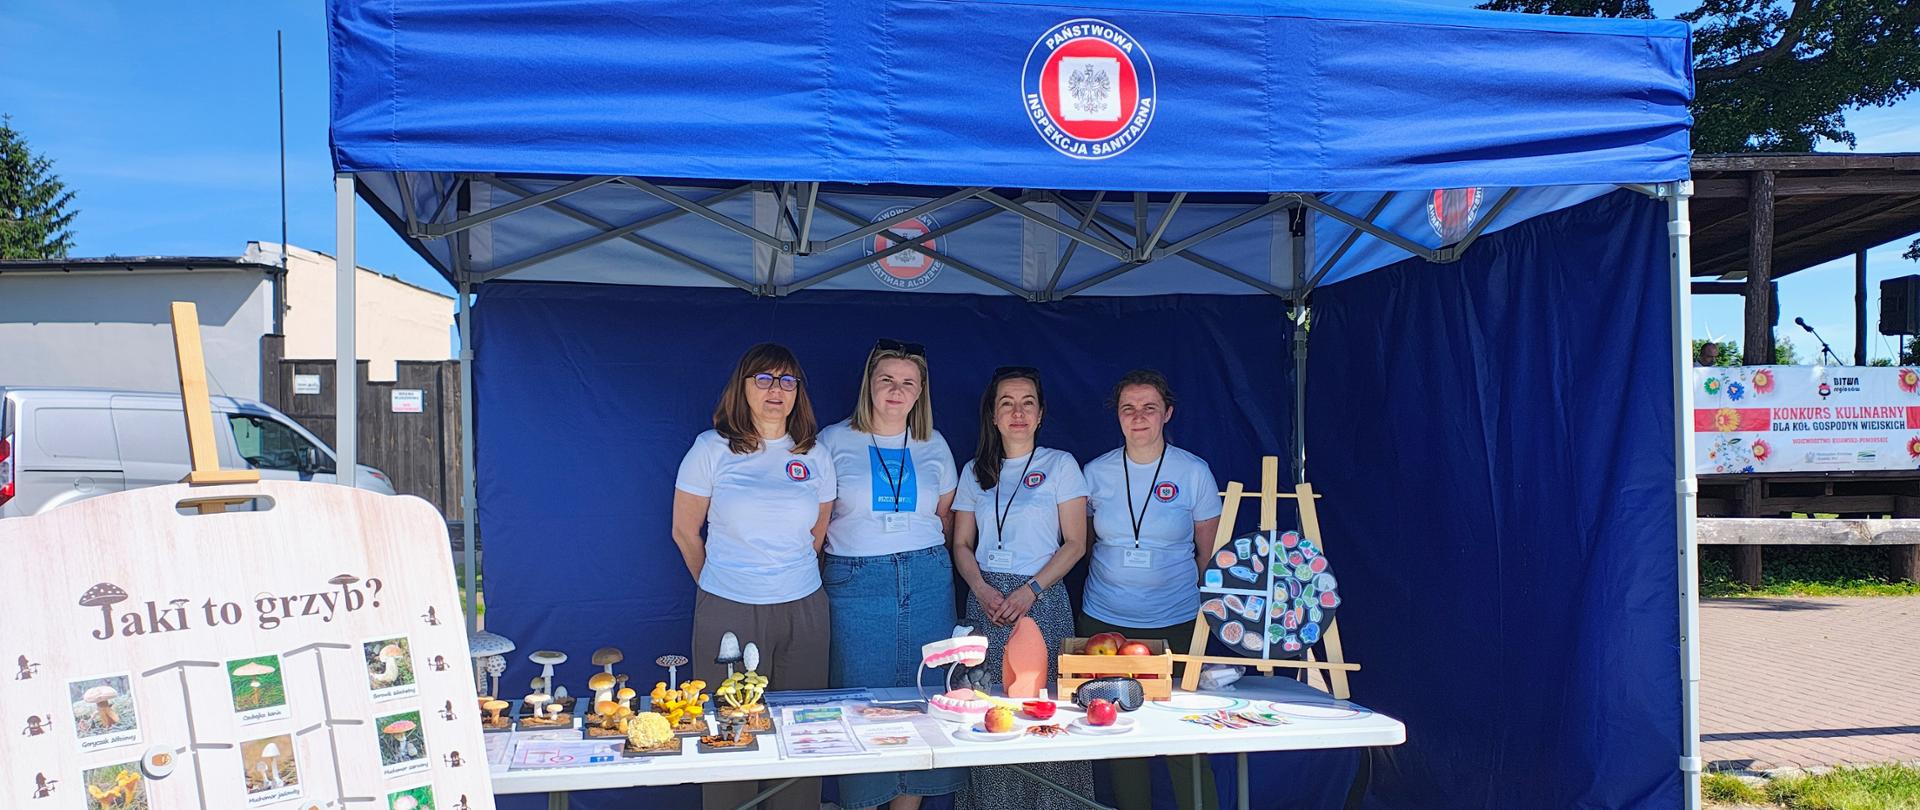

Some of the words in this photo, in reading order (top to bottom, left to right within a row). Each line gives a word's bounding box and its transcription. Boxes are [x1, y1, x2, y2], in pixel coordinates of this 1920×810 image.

[1045, 24, 1134, 54] PAŃSTWOWA
[1028, 93, 1088, 155] INSPEKCJA
[1092, 97, 1152, 155] SANITARNA
[1834, 377, 1859, 386] BITWA
[1772, 406, 1832, 420] KONKURS
[1835, 406, 1905, 419] KULINARNY
[1772, 422, 1791, 432] DLA
[1860, 419, 1906, 430] WIEJSKICH
[85, 590, 192, 642] Jaki
[201, 595, 244, 628] to
[254, 575, 384, 631] grzyb?
